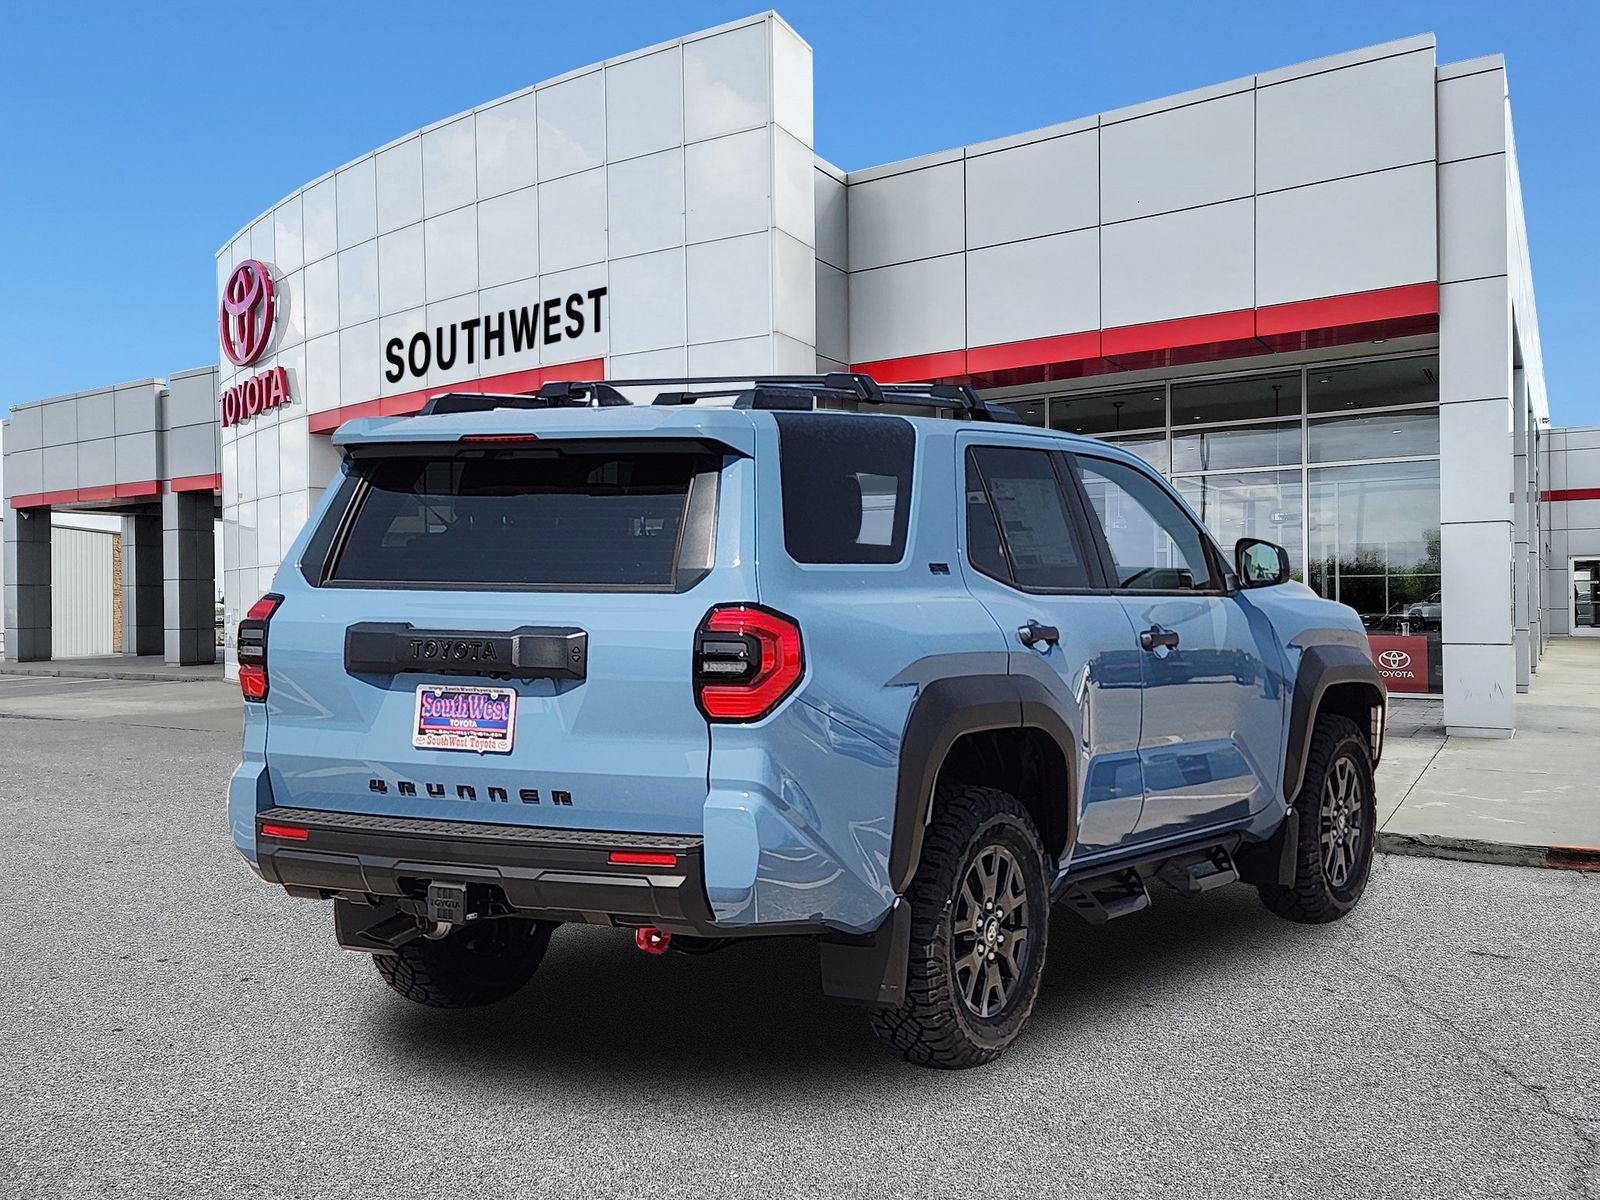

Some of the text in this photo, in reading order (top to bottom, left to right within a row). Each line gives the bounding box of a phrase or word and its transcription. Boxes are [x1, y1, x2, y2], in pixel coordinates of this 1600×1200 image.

[385, 286, 607, 384] SOUTHWEST
[218, 366, 291, 428] TOYOTA
[409, 640, 497, 660] TOYOTA
[450, 720, 477, 728] TOYOTA
[470, 738, 497, 749] Toyota
[369, 778, 574, 806] 4RUNNER
